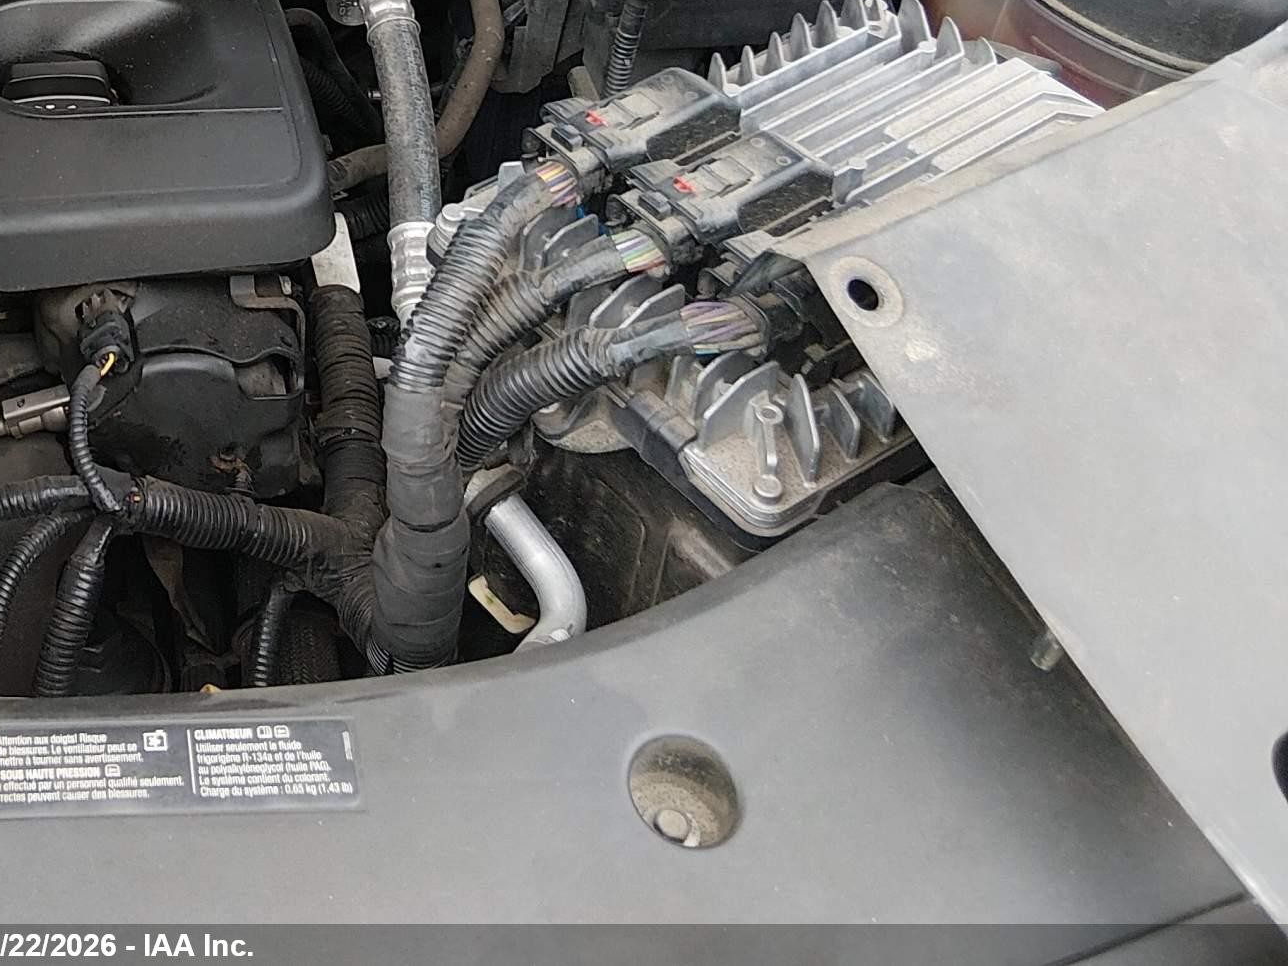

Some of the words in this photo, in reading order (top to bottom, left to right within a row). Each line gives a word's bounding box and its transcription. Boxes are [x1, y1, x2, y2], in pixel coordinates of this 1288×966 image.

[194, 728, 253, 740] CLIMATISEUR
[34, 736, 48, 745] aux
[269, 742, 277, 750] le
[279, 740, 301, 750] fluide
[52, 746, 62, 755] Le
[32, 755, 62, 765] tourner
[64, 755, 83, 764] sans
[242, 753, 273, 763] R-134a
[275, 753, 283, 761] et
[284, 752, 295, 761] de
[0, 770, 24, 780] SOUS
[25, 768, 54, 779] HAUTE
[56, 767, 100, 778] PRESSION
[198, 765, 209, 774] au
[38, 781, 52, 791] par
[54, 781, 65, 789] un
[66, 778, 106, 790] personnel
[199, 776, 210, 785] Le
[282, 773, 293, 782] du
[62, 791, 90, 801] causer
[92, 790, 106, 799] des
[200, 787, 230, 799] Charge
[232, 786, 242, 795] du
[306, 784, 316, 795] kg
[319, 783, 340, 794] (1.43
